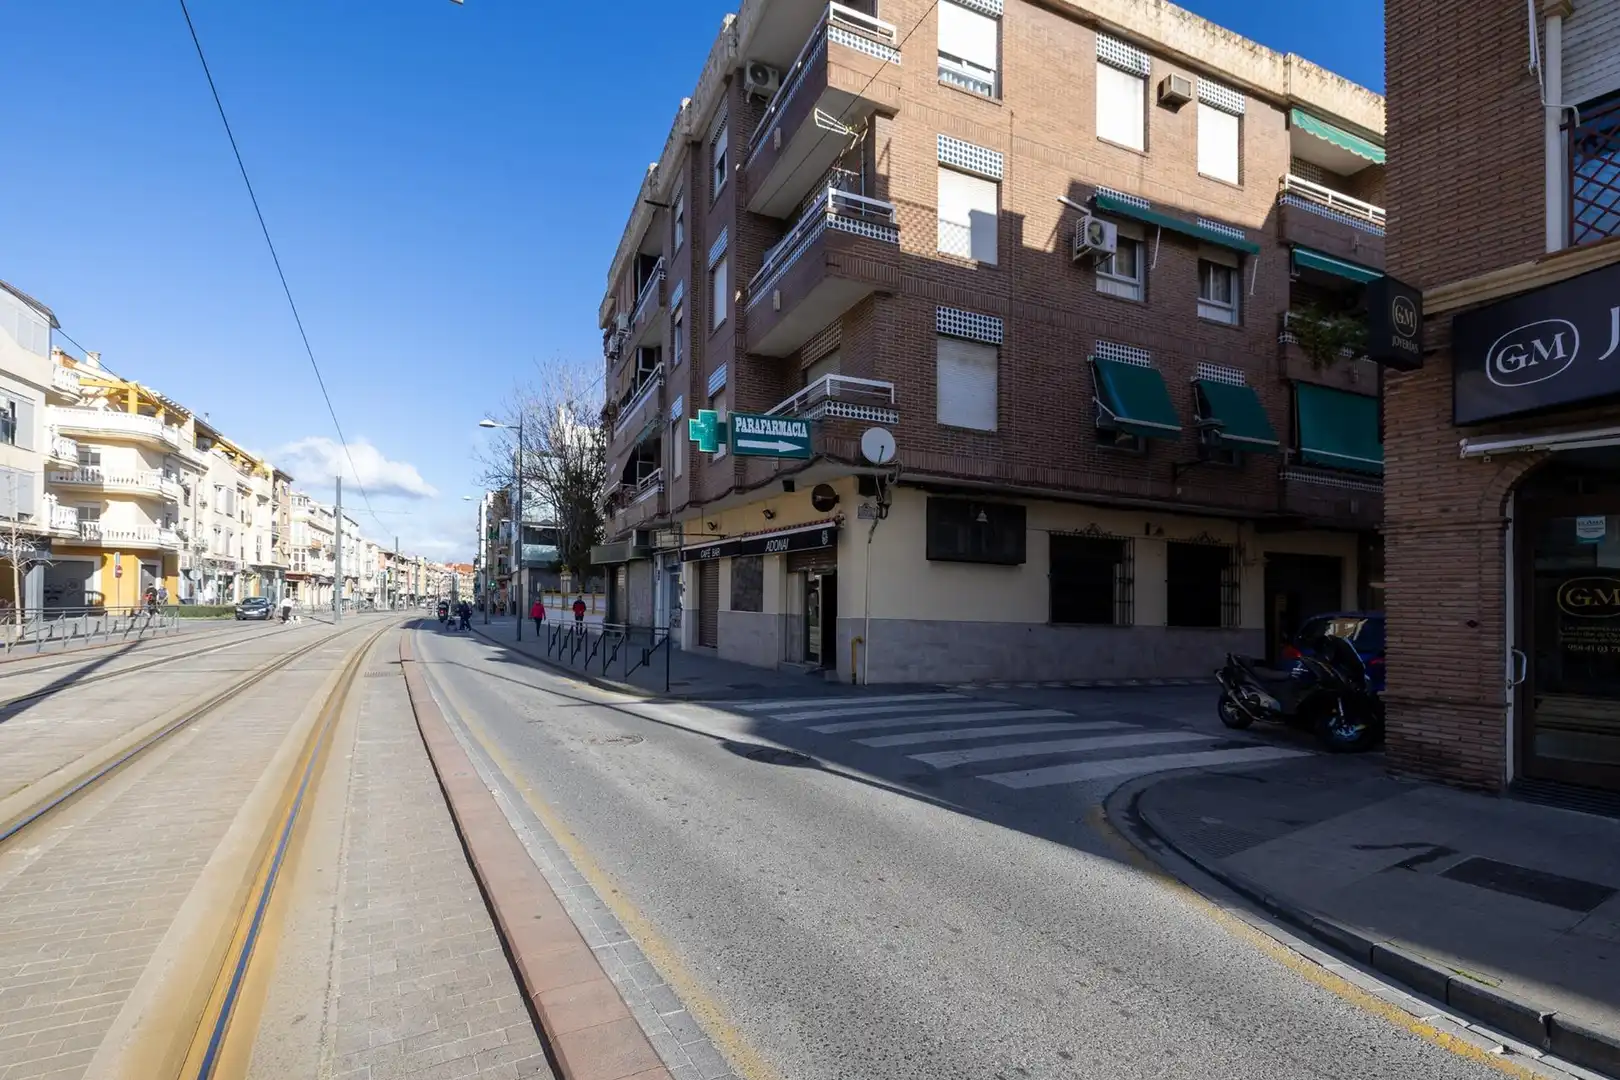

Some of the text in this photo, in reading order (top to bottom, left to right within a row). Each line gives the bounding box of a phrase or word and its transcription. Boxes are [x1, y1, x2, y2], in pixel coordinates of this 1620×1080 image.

[1395, 304, 1413, 328] GM
[1496, 332, 1568, 374] GM
[734, 417, 808, 438] PARAFARMACIA
[711, 547, 721, 557] BAR
[1565, 587, 1620, 607] GM
